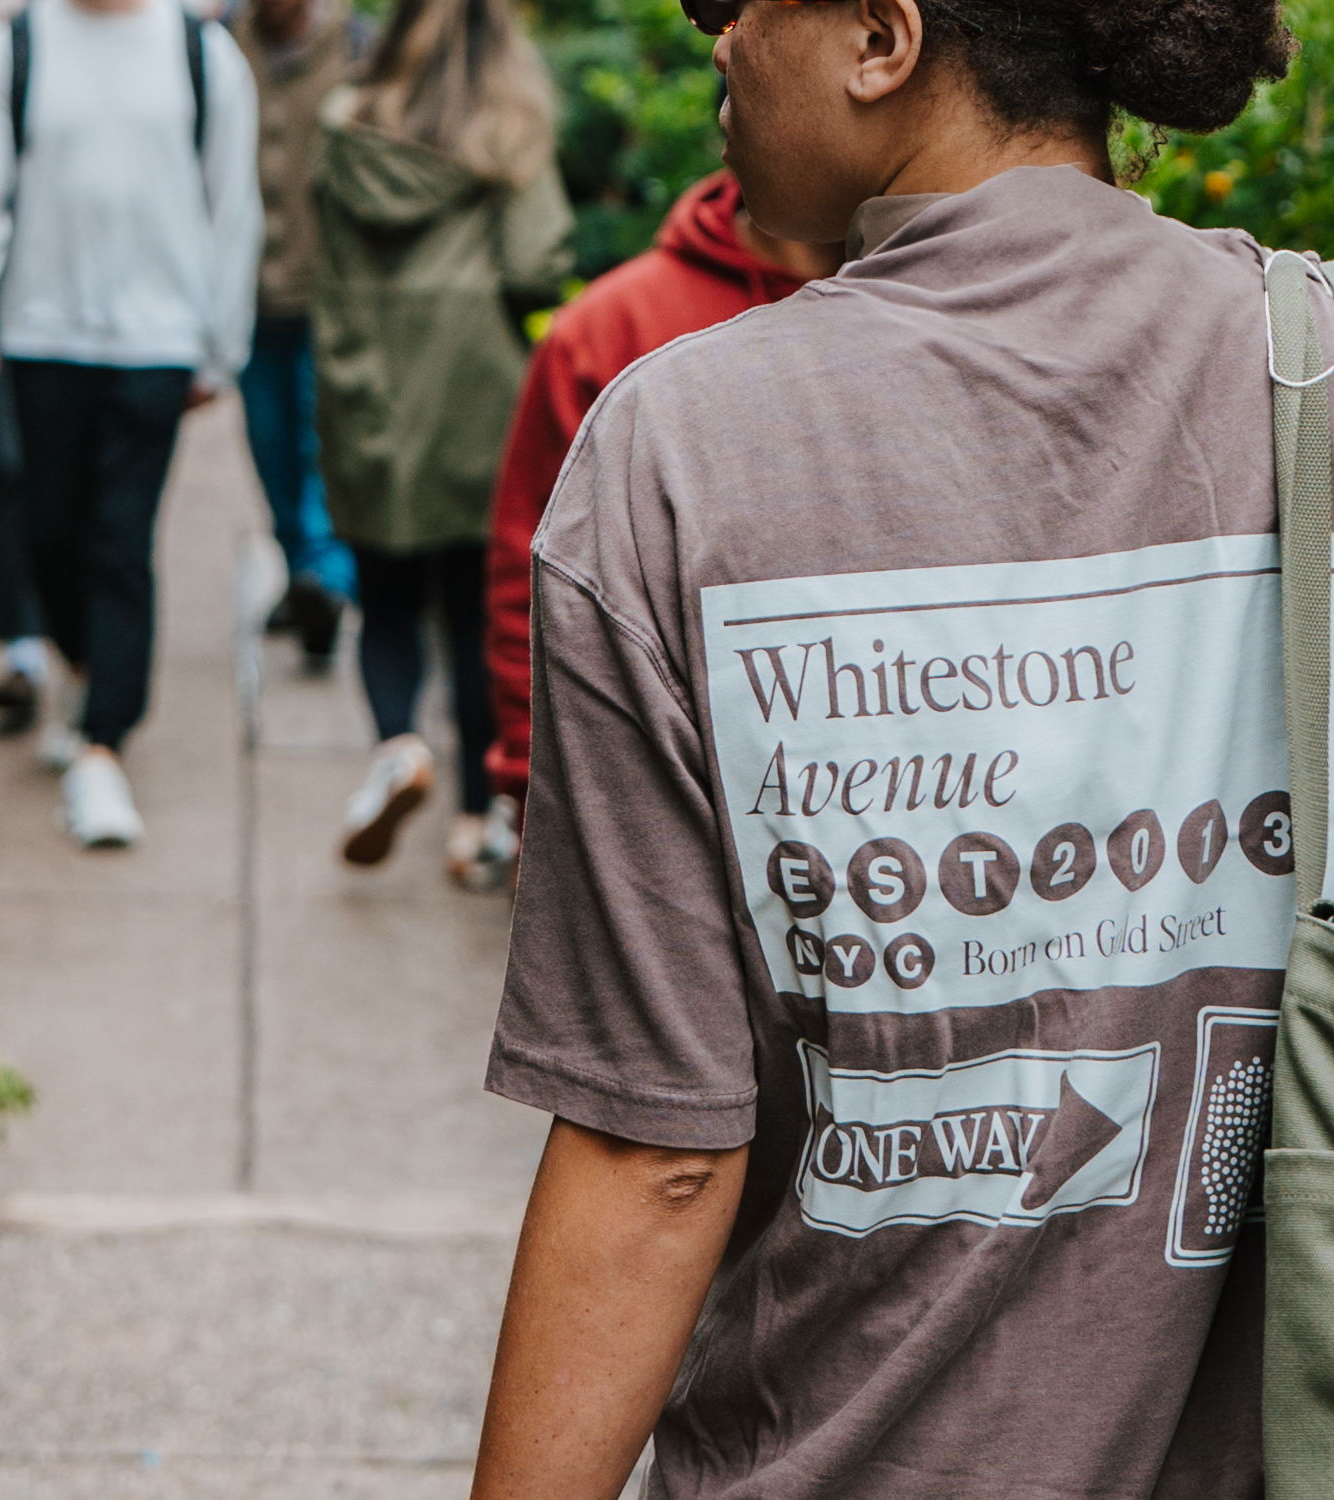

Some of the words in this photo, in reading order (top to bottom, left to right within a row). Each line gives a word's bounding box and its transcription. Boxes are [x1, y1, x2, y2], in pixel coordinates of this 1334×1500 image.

[732, 635, 1137, 724] Whitestone
[744, 739, 1021, 818] Avenue
[792, 937, 924, 981] NYC
[961, 938, 1037, 977] Born
[1043, 930, 1086, 962] on
[1095, 913, 1149, 959] Gold
[1158, 904, 1228, 954] Street
[814, 1121, 924, 1185] ONE
[930, 1110, 1046, 1173] WAY
